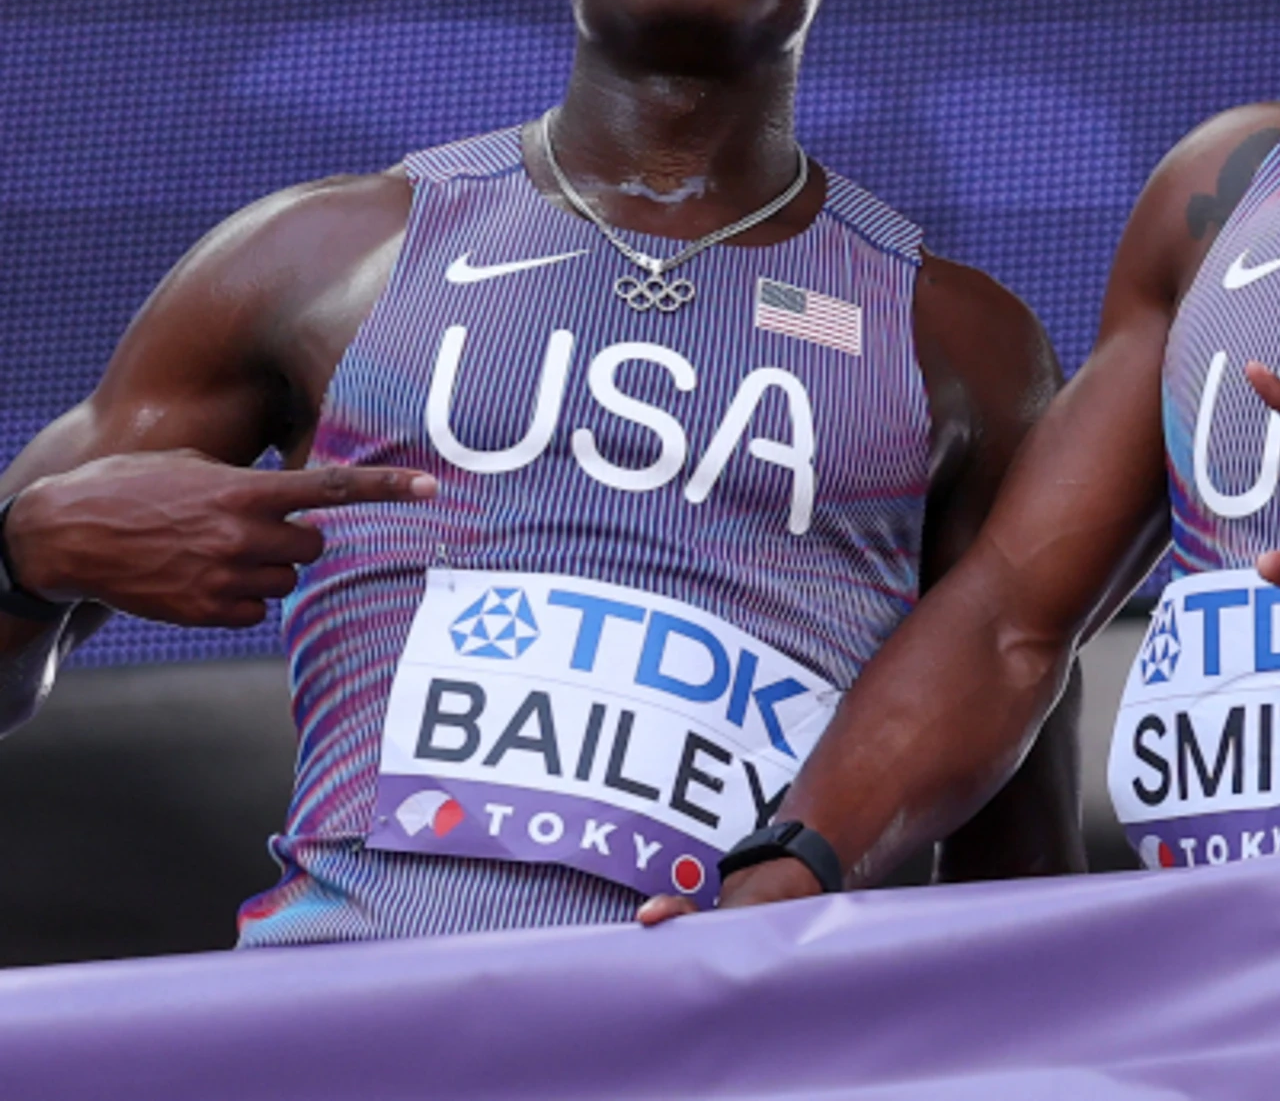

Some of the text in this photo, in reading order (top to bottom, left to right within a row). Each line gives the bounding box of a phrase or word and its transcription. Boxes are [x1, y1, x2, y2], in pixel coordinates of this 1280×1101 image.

[425, 325, 817, 535] USA
[413, 677, 792, 830] BAILEY
[547, 588, 810, 760] TDK
